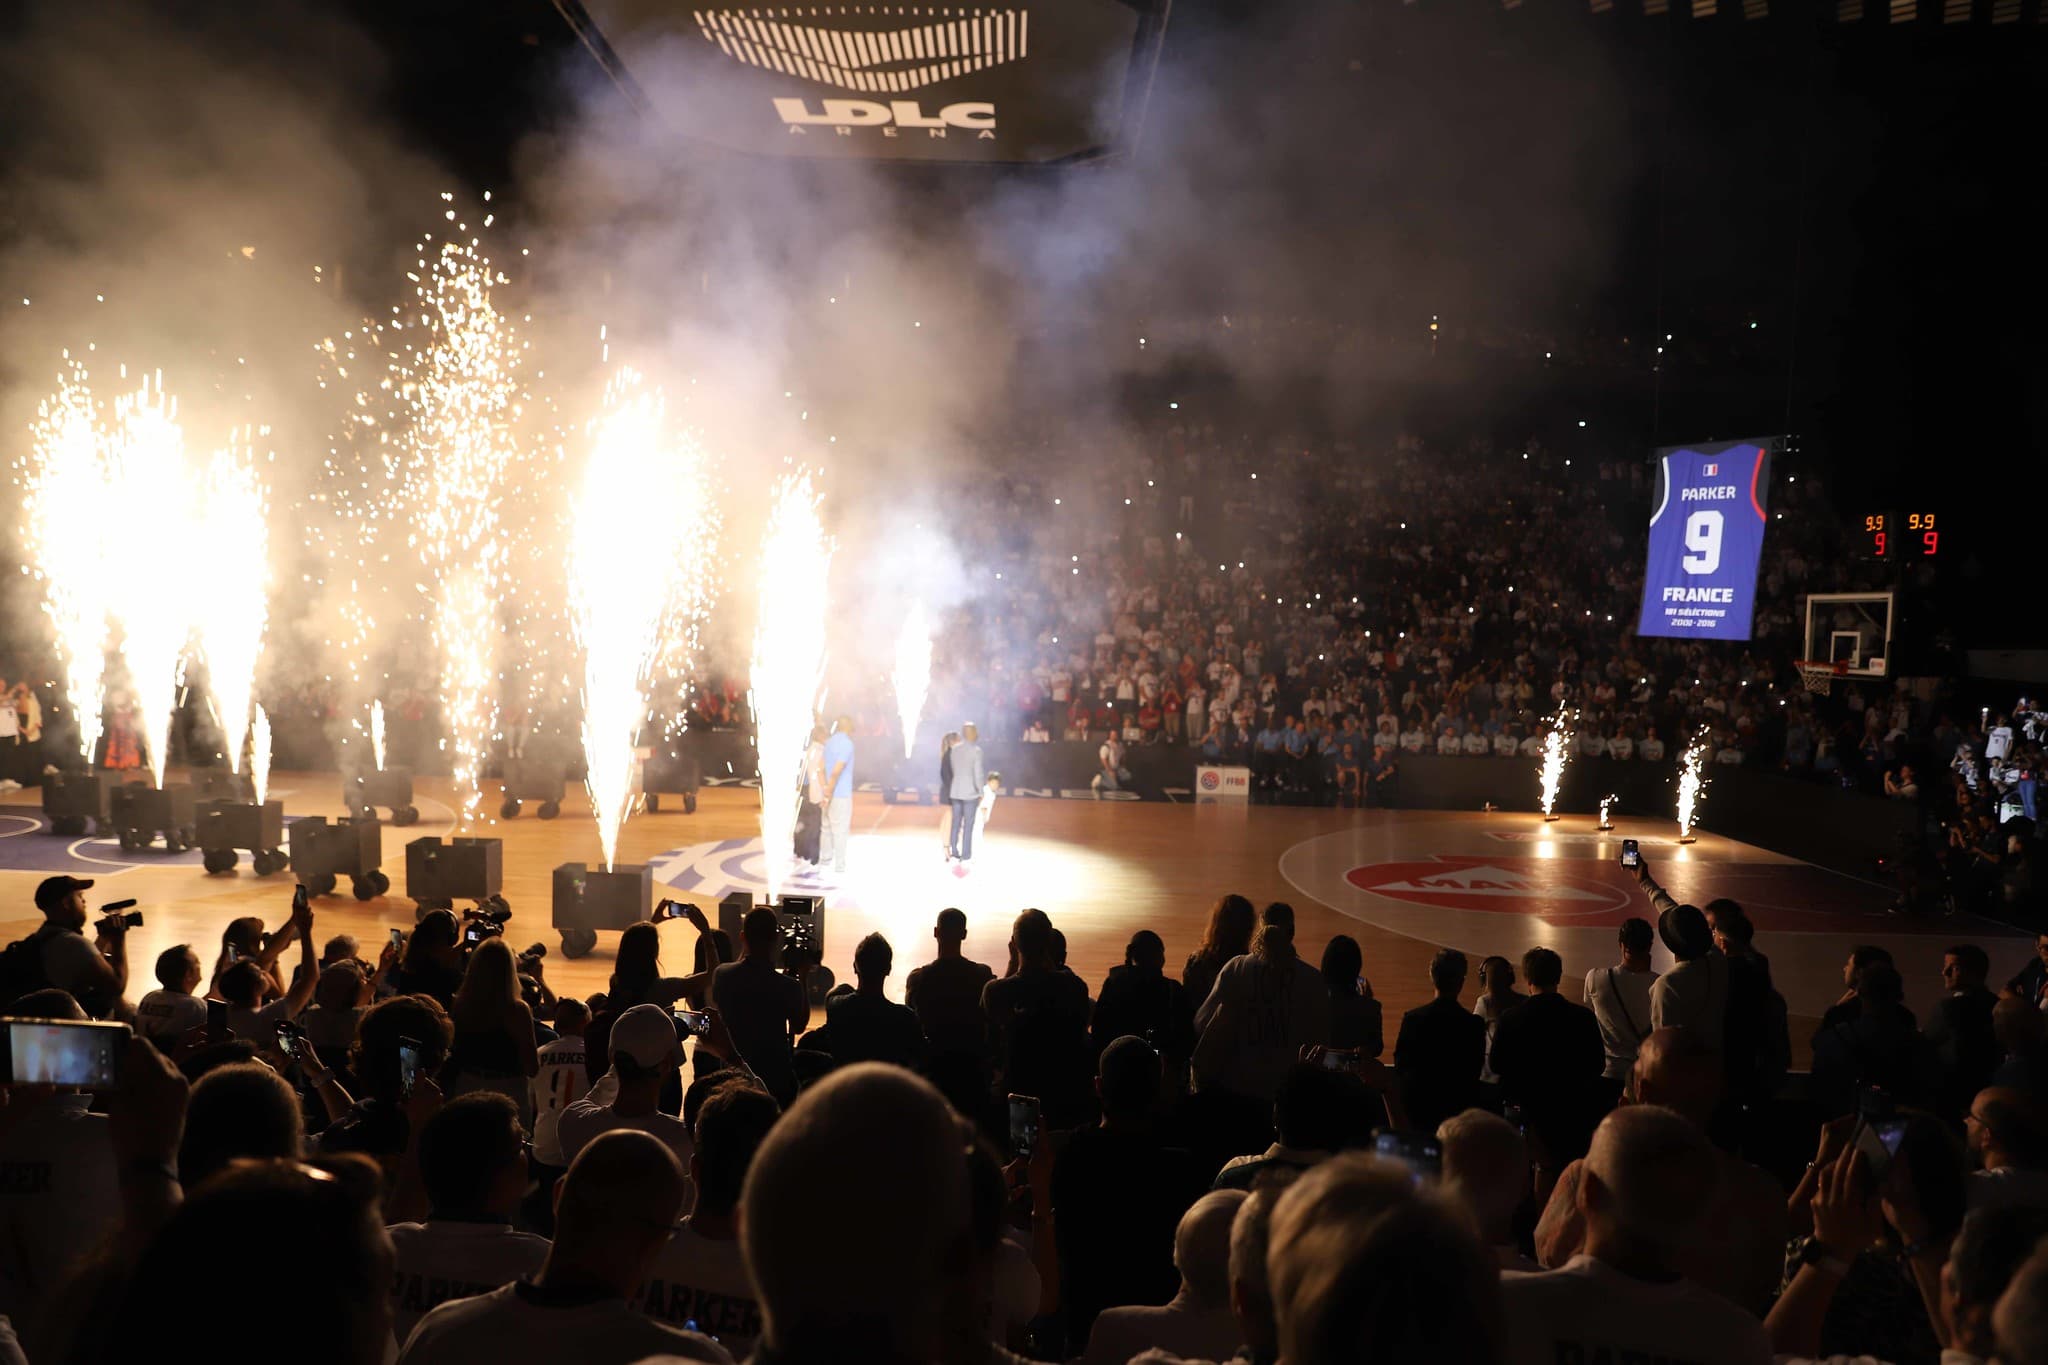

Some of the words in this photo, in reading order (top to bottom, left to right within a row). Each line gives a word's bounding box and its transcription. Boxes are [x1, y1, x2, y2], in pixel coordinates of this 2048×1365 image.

[773, 98, 996, 128] LDLC
[789, 124, 996, 139] ARENA
[1681, 486, 1736, 501] PARKER
[1866, 515, 1884, 531] 9.9
[1909, 513, 1935, 530] 9.9
[1682, 510, 1724, 575] 9
[1875, 532, 1886, 555] 9
[1923, 531, 1938, 555] 9
[1662, 586, 1734, 603] FRANCE
[540, 1052, 586, 1067] PARKE
